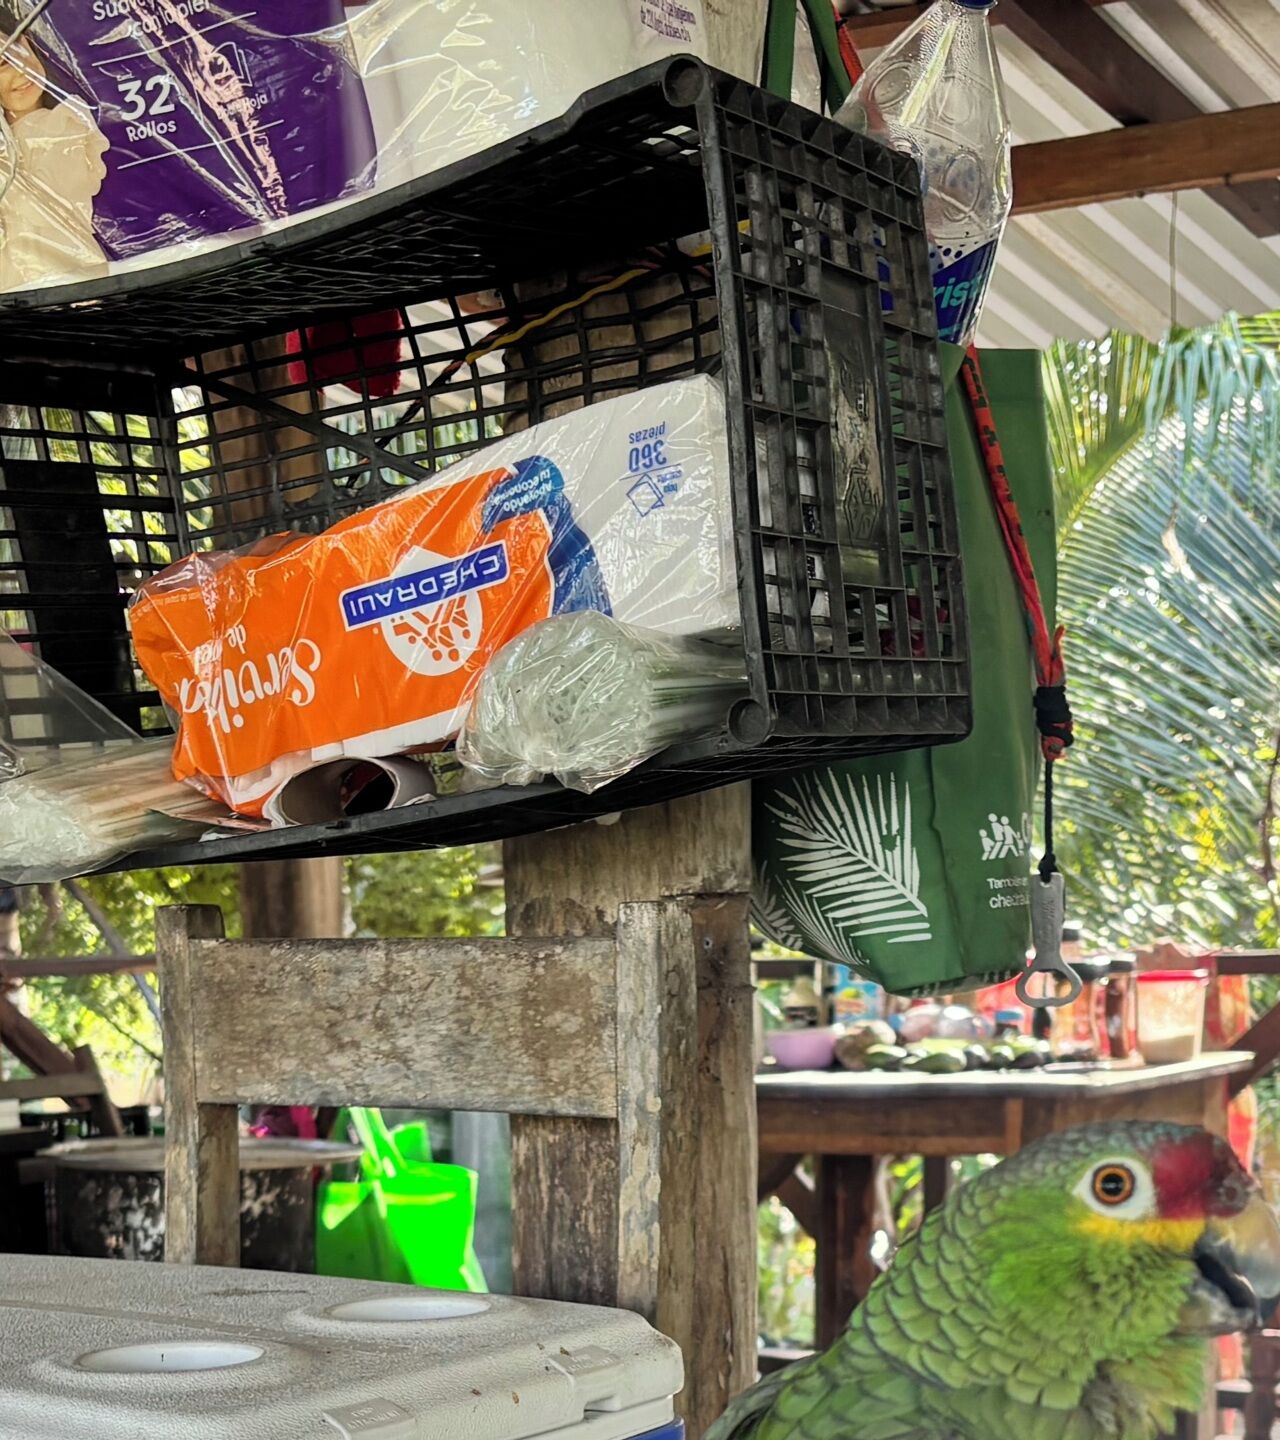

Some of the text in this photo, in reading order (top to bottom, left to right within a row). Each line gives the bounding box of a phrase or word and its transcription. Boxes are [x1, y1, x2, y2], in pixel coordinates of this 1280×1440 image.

[117, 74, 175, 121] 32
[125, 120, 177, 142] Rollos
[629, 420, 666, 444] piezas
[629, 440, 667, 473] 360
[502, 479, 553, 512] Apoyando
[349, 554, 500, 617] CHEDRAUI
